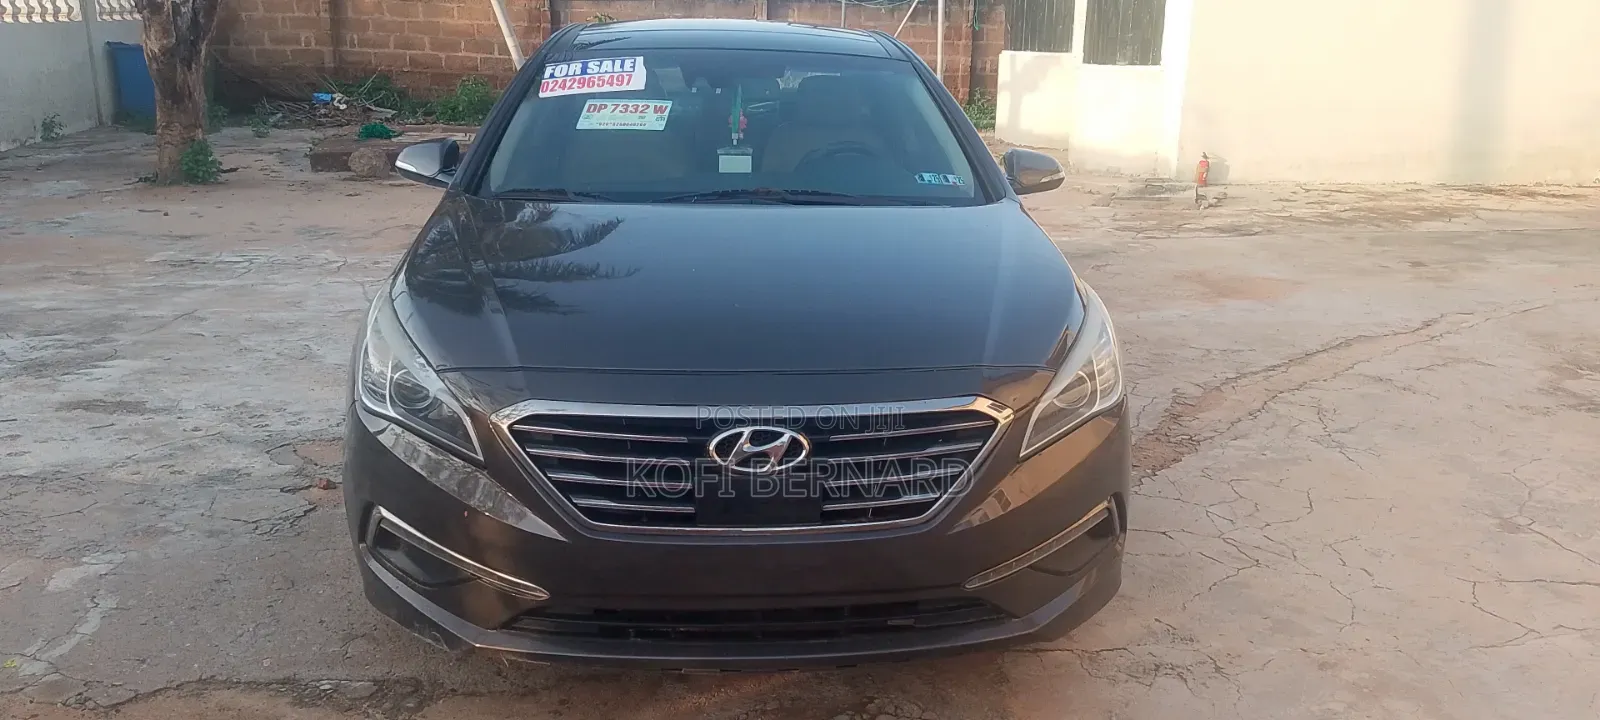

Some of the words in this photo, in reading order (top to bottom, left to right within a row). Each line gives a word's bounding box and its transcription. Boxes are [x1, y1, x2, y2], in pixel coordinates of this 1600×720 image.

[543, 62, 582, 79] FOR
[586, 58, 635, 74] SALE
[540, 74, 633, 93] 0242965497
[586, 104, 608, 114] DP
[610, 104, 651, 114] 7332
[653, 105, 668, 115] W
